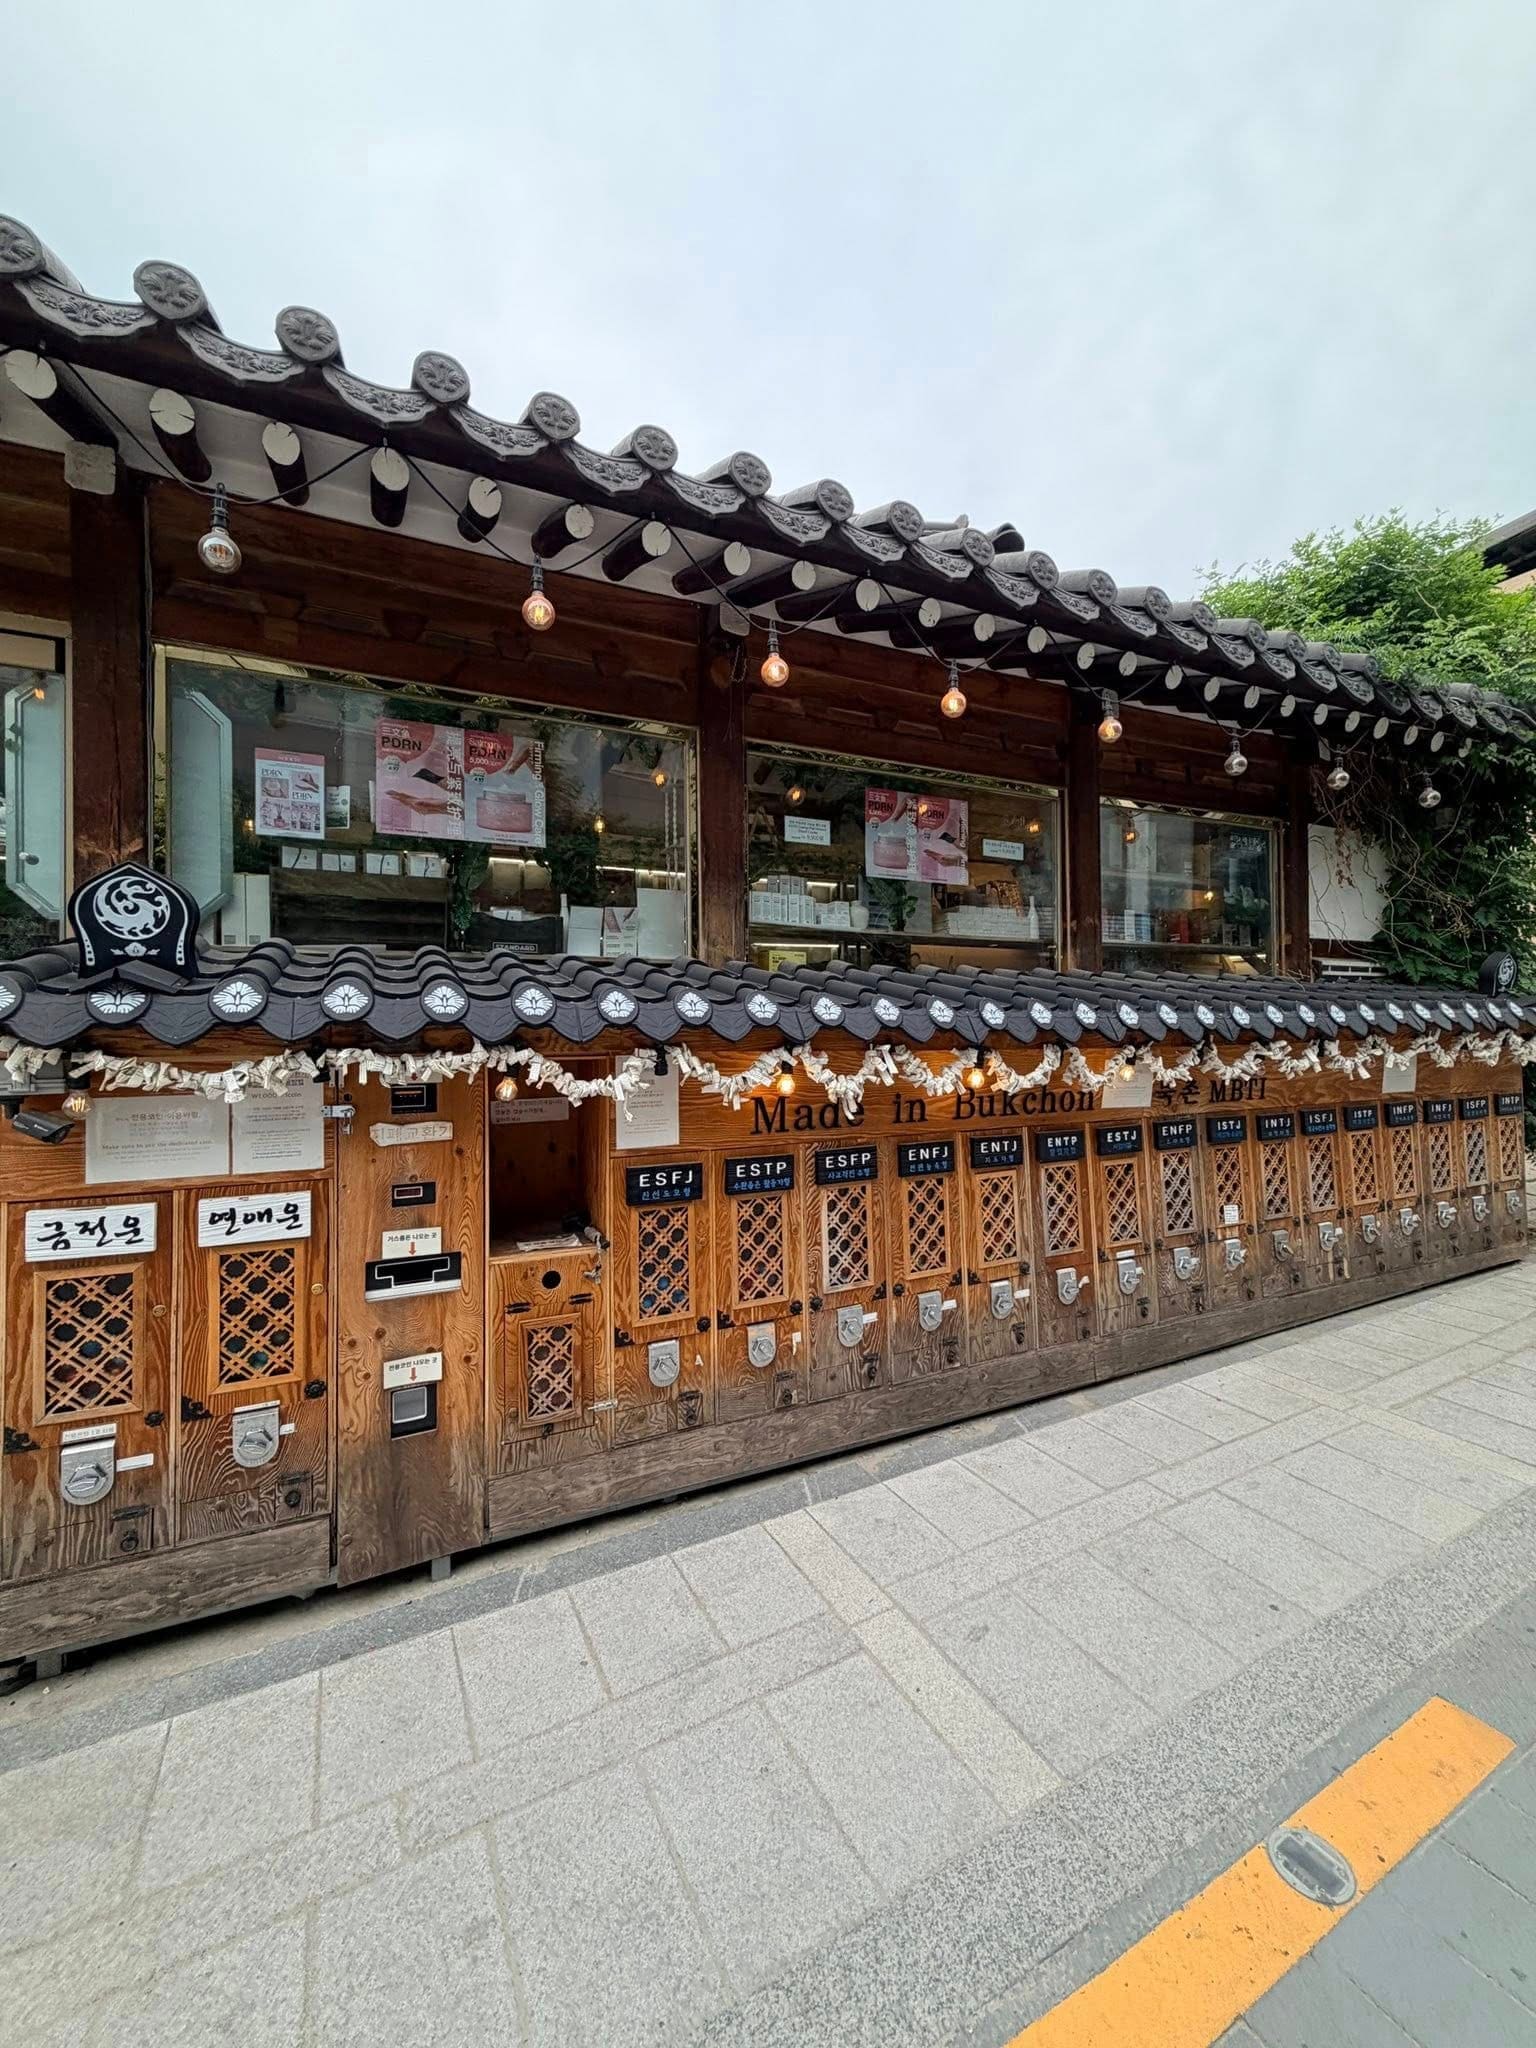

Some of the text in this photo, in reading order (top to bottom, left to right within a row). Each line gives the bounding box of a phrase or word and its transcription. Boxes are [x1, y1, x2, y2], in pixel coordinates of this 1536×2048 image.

[381, 736, 422, 751] PDRN
[469, 746, 507, 760] PDRN
[532, 741, 545, 780] Firming
[1208, 1078, 1268, 1103] MBTI
[1466, 1099, 1487, 1109] ISFP
[1501, 1095, 1520, 1105] INTP
[750, 1095, 865, 1135] Made
[893, 1092, 929, 1124] in
[952, 1084, 1096, 1120] Bukchon
[1392, 1104, 1415, 1114] INFP
[1216, 1119, 1242, 1131] ISTJ
[1265, 1117, 1291, 1129] INTJ
[1309, 1112, 1334, 1124] ISFJ
[1106, 1130, 1137, 1143] ESTJ
[1161, 1123, 1193, 1137] ENFP
[980, 1139, 1018, 1154] ENTJ
[1047, 1136, 1079, 1148] ENTP
[908, 1145, 949, 1161] ENFJ
[825, 1152, 872, 1169] ESFP
[736, 1161, 788, 1178] ESTP
[639, 1169, 694, 1187] ESFJ
[208, 1202, 304, 1236] 연애운
[36, 1215, 145, 1251] 금전운
[387, 1231, 438, 1242] 거스름돈 나오는 곳
[412, 1358, 430, 1366] 나오는
